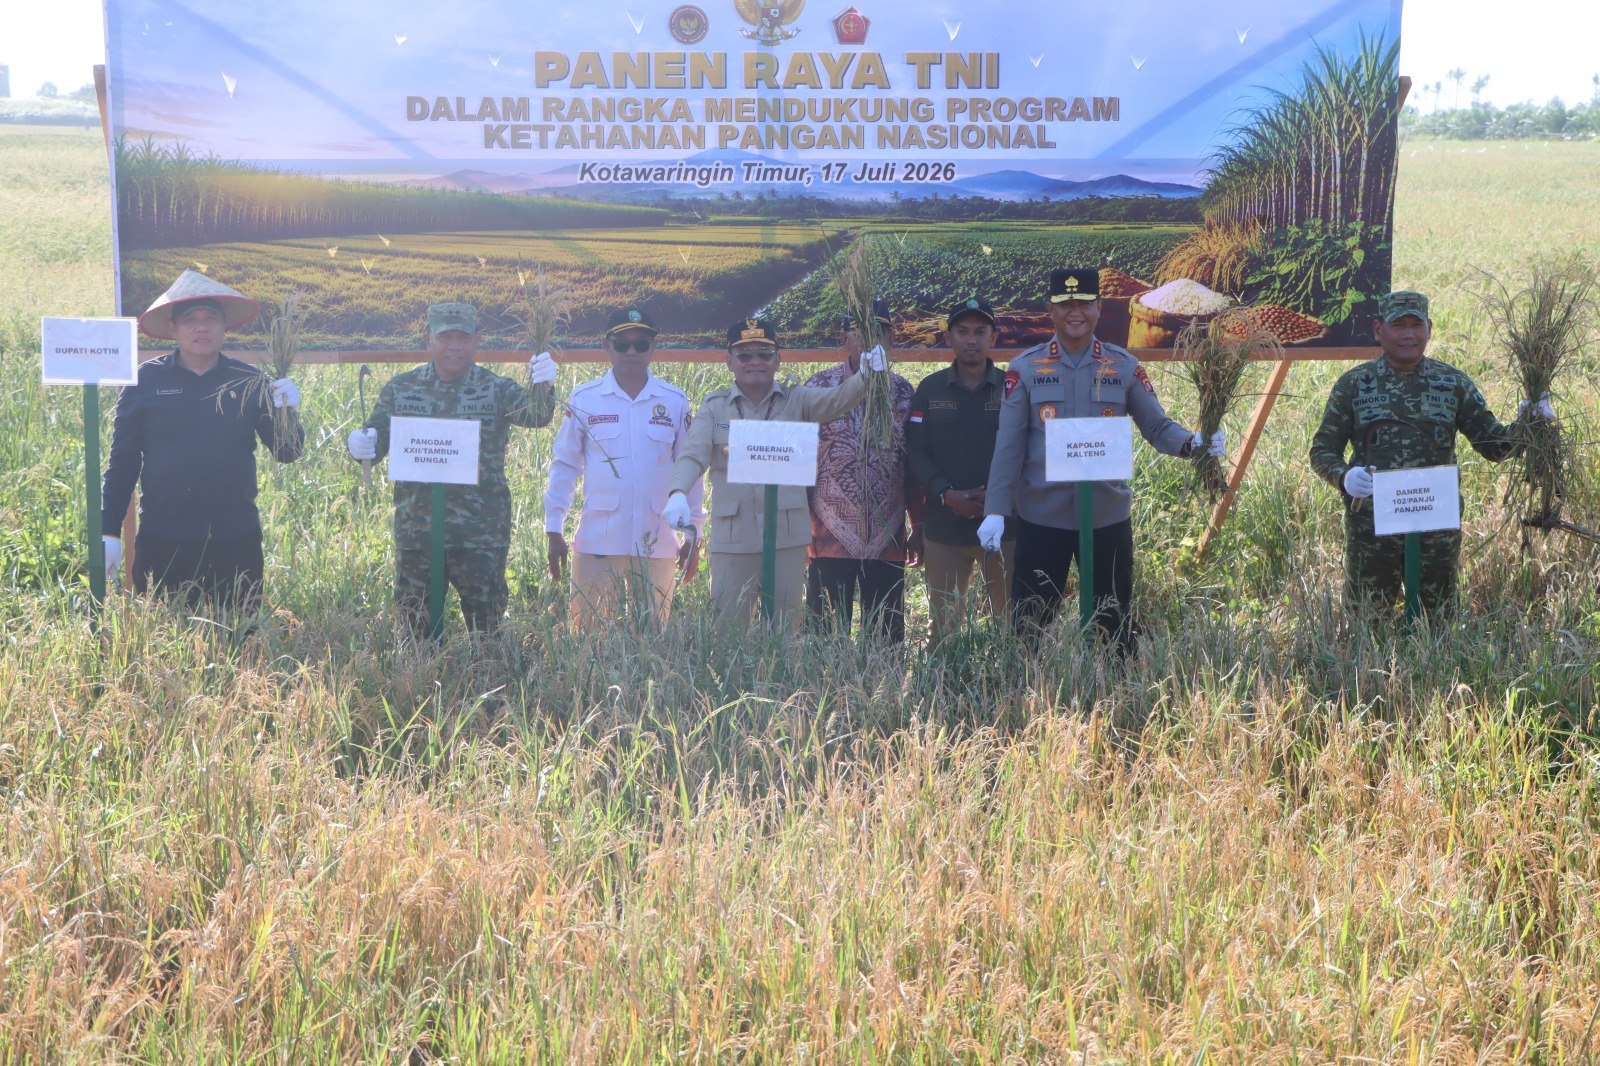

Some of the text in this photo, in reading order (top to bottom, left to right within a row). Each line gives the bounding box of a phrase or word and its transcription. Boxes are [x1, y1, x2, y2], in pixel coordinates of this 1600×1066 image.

[534, 51, 1000, 90] PANEN RAYA TNI
[405, 96, 1120, 123] DALAM RANGKA MENDUKUNG PROGRAM
[483, 123, 1057, 149] KETAHANAN PANGAN NASIONAL
[578, 162, 956, 185] Kotawaringin Timur, 17 Juli 2026
[1033, 375, 1060, 385] IWAN
[1353, 396, 1387, 407] WIMOKO
[1425, 395, 1456, 405] TNI AD
[397, 404, 428, 413] ZAINUL
[462, 403, 494, 412] TNI AD
[648, 419, 674, 427] GERINDRA
[410, 438, 453, 446] PANGDAM
[1066, 441, 1106, 449] KAPOLDA
[403, 447, 459, 456] XXII/TAMBUN
[746, 445, 794, 453] GUBERNUR
[750, 454, 790, 462] KALTENG
[1066, 450, 1106, 458] KALTENG
[414, 456, 448, 464] BUNGAI
[1396, 487, 1430, 496] DANREM
[1392, 496, 1435, 504] 102/PANJU
[1394, 505, 1433, 513] PANJUNG
